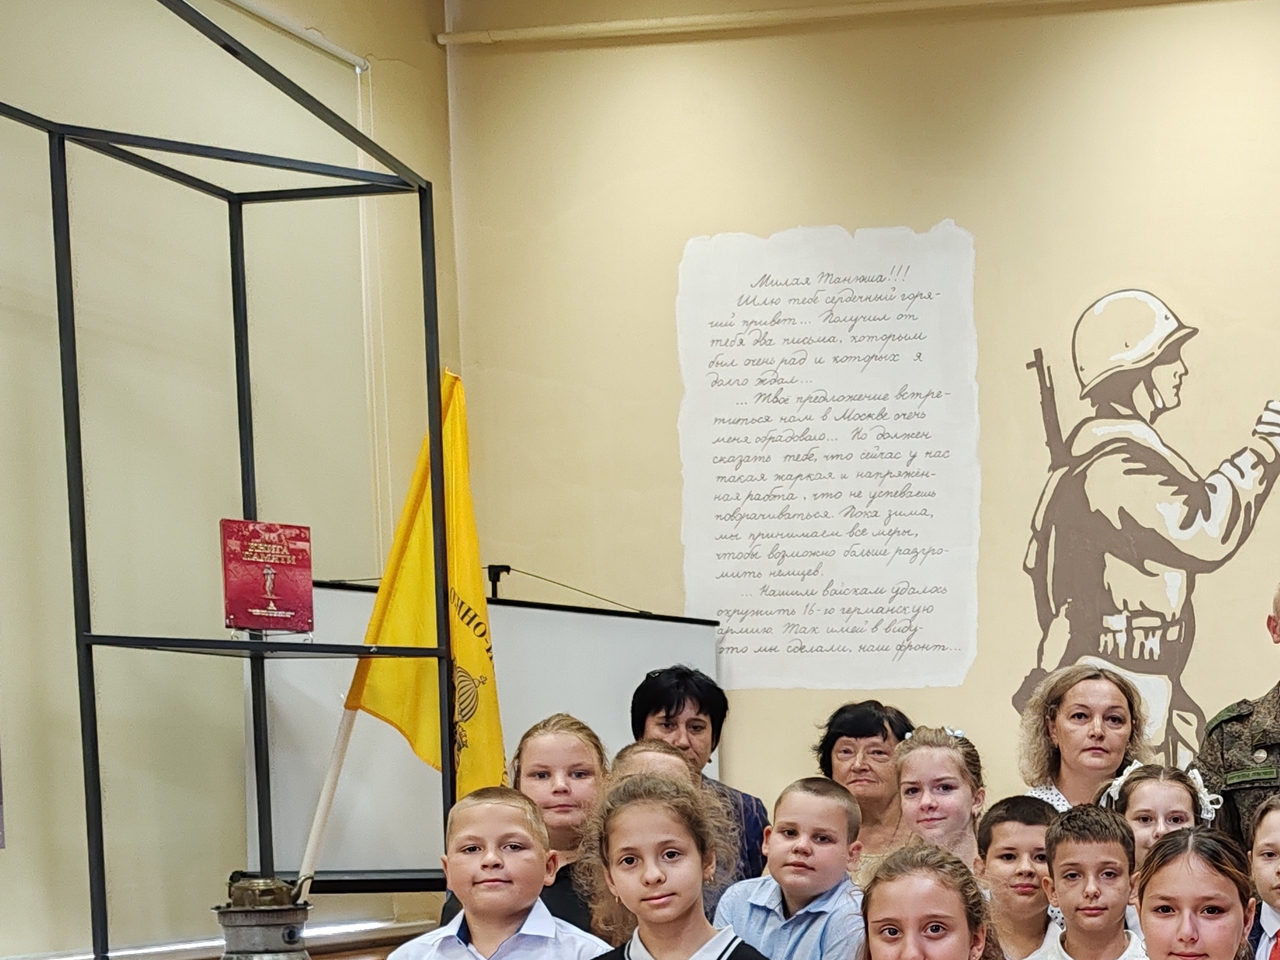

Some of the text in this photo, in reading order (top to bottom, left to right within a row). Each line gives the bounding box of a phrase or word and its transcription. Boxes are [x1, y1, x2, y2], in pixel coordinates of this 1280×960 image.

[750, 265, 910, 288] Милая Танюша!!!
[737, 287, 940, 311] Шлю тебе сердечный горя-
[709, 313, 735, 328] чий
[742, 311, 811, 333] привет...
[819, 309, 891, 332] Получил
[711, 329, 927, 353] тебя два письма, которым
[709, 353, 738, 368] был
[744, 358, 775, 366] очень
[774, 349, 808, 377] рад
[833, 354, 899, 372] которых
[913, 352, 923, 362] я
[707, 367, 812, 387] долго ждал...
[796, 389, 889, 415] предложение
[895, 384, 950, 409] встре-
[714, 407, 926, 425] титься нам в Москве очень
[712, 425, 932, 451] меня обрадовало... Но должен
[713, 446, 950, 471] сказать тебе, что сейчас у нас
[716, 473, 767, 483] такая
[774, 472, 835, 489] жаркая
[714, 493, 741, 502] ная
[736, 486, 806, 507] работа,
[812, 491, 842, 500] что
[866, 483, 936, 508] успеваешь
[715, 505, 933, 529] поворачиваться. Пока зима,
[749, 530, 842, 548] принимаем
[846, 523, 868, 537] все
[872, 527, 918, 545] меры,
[242, 551, 297, 565] ПАМЯТИ
[248, 542, 289, 555] КНИГА
[716, 543, 948, 566] чтобы возможно больше разгро-
[716, 562, 823, 582] мить немцев.
[760, 585, 818, 597] Нашим
[822, 579, 886, 596] войскам
[889, 581, 947, 604] удалось
[717, 609, 799, 628] окружить
[840, 605, 934, 625] германскую
[717, 614, 923, 643] армию. Так имей в виду-
[717, 645, 748, 657] это
[787, 639, 852, 653] сделали,
[892, 640, 961, 661] фронт...
